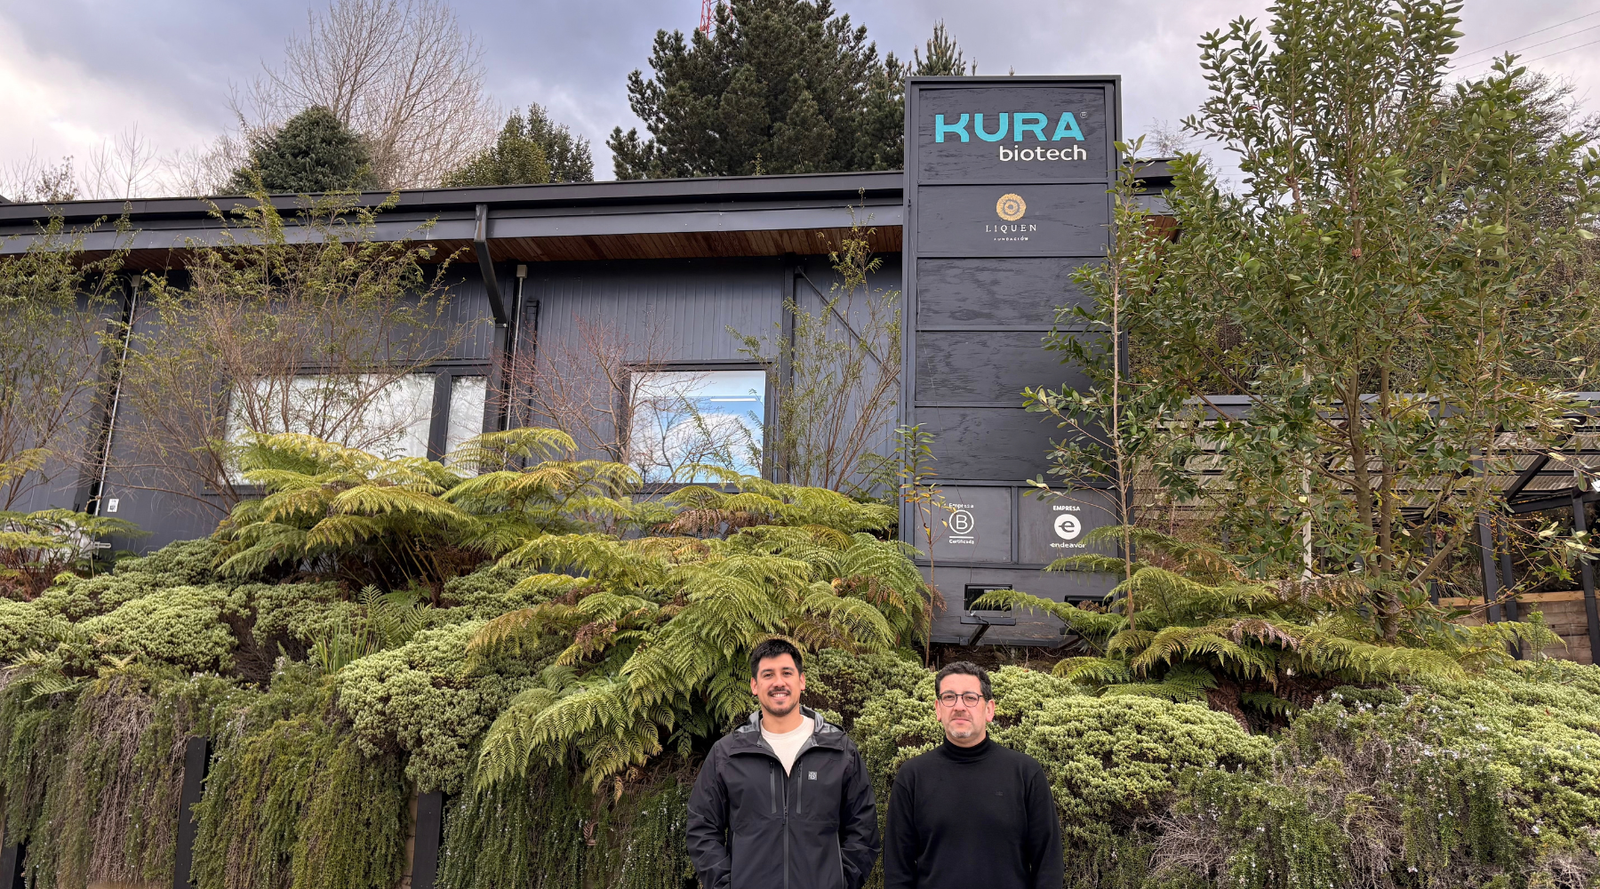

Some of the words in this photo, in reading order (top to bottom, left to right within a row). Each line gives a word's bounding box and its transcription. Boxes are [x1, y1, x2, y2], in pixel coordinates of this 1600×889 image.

[935, 112, 1085, 143] KURA
[999, 145, 1087, 161] biotech
[985, 224, 1037, 234] LIQUEN
[956, 514, 968, 530] B
[1050, 541, 1086, 549] endeavor
